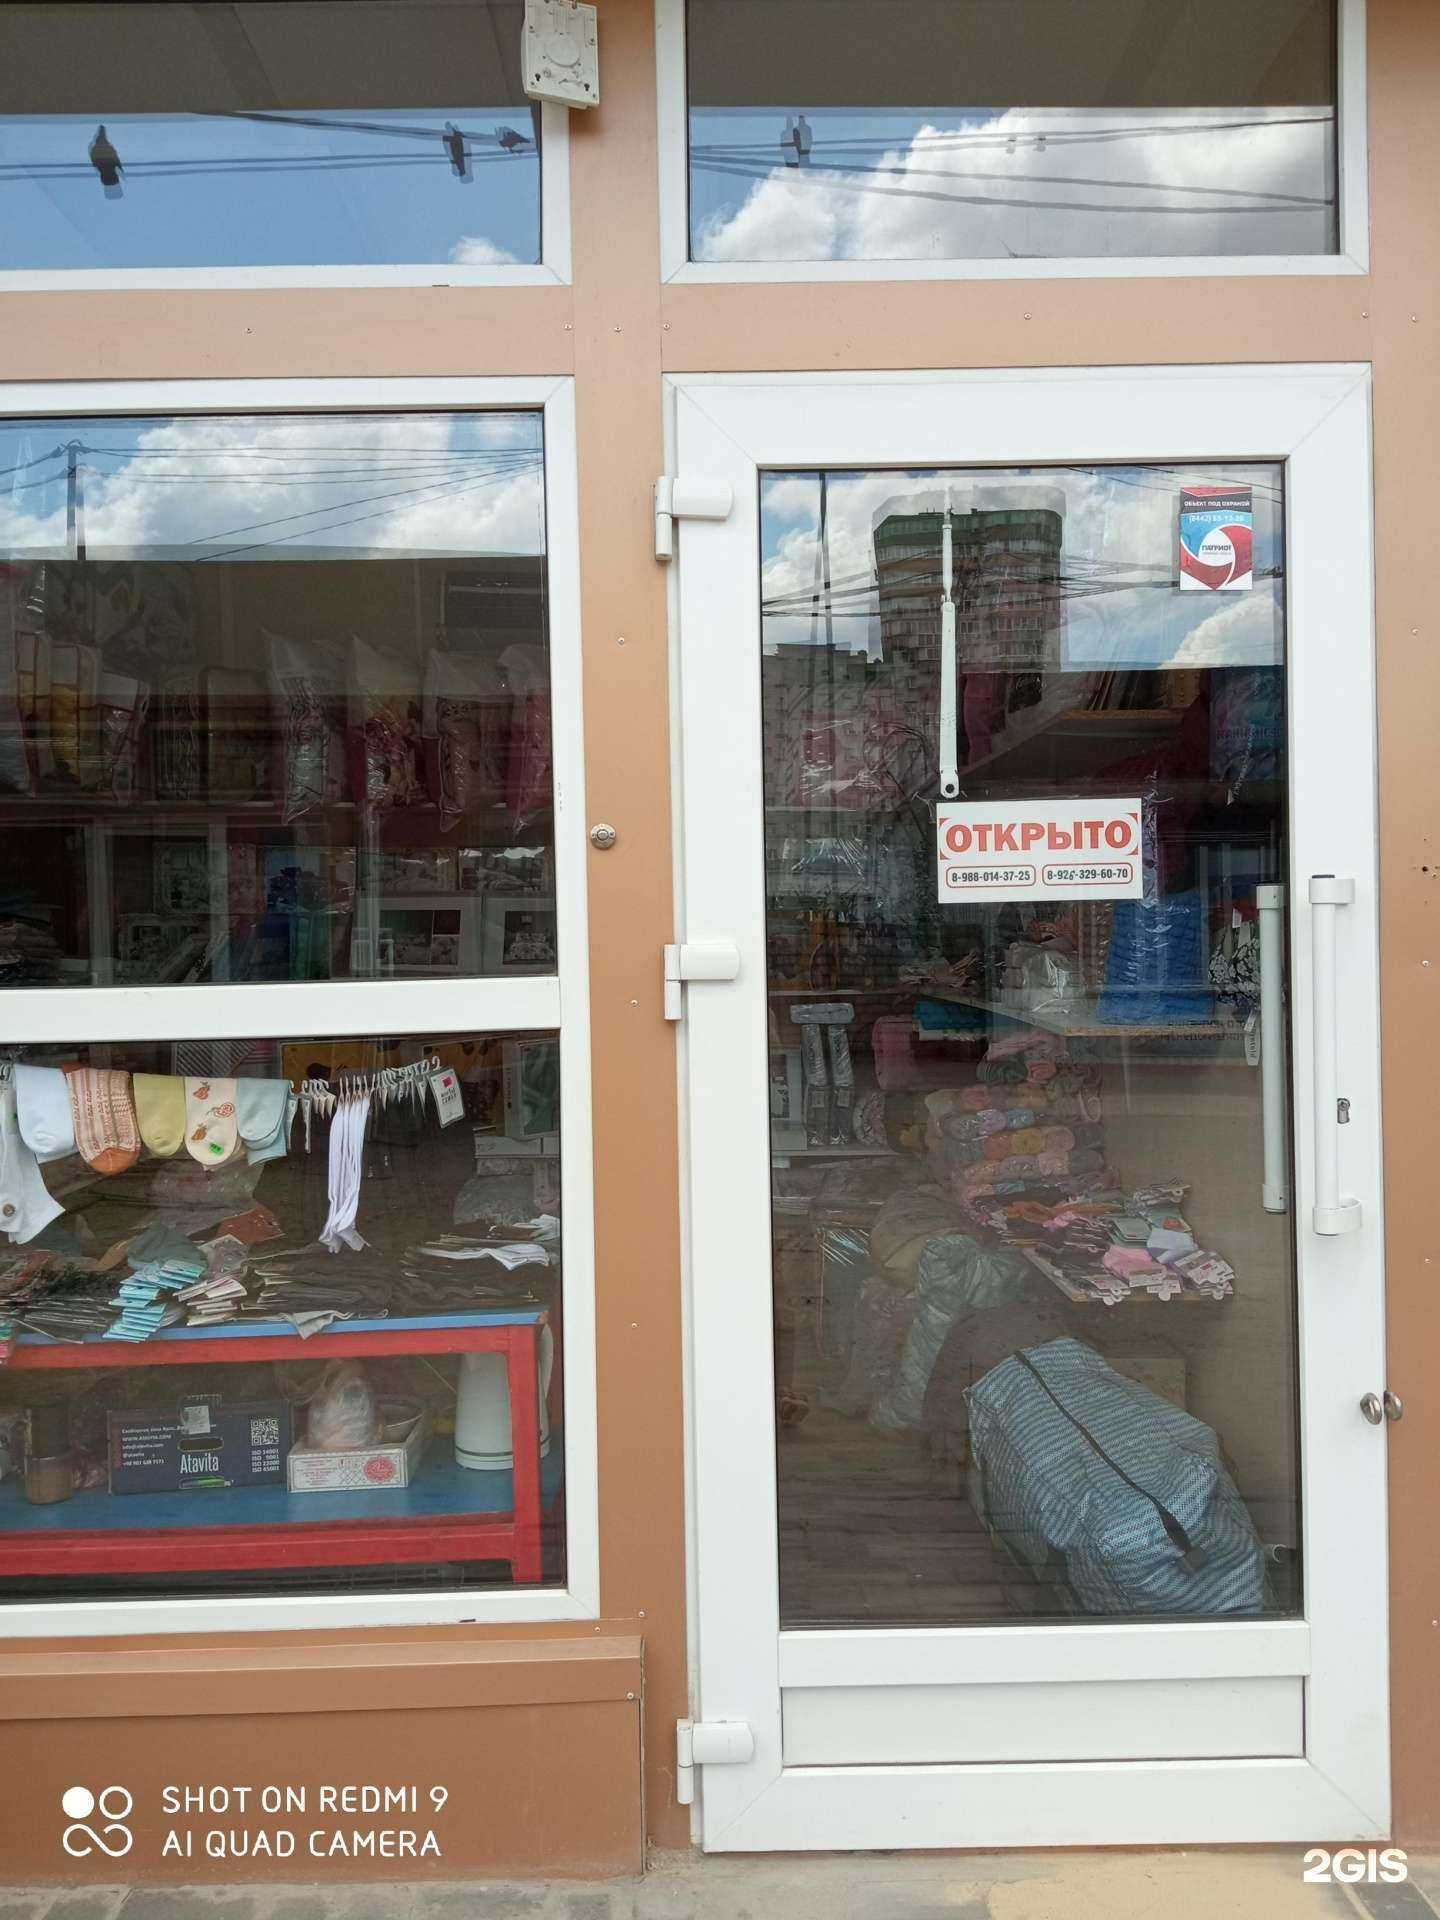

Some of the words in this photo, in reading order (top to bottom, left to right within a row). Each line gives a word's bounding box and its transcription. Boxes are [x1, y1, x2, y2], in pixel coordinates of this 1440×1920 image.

[946, 819, 1132, 853] ОТКРЫТО
[952, 870, 1031, 882] 8-988-014-37-25
[180, 1452, 219, 1474] Atavita
